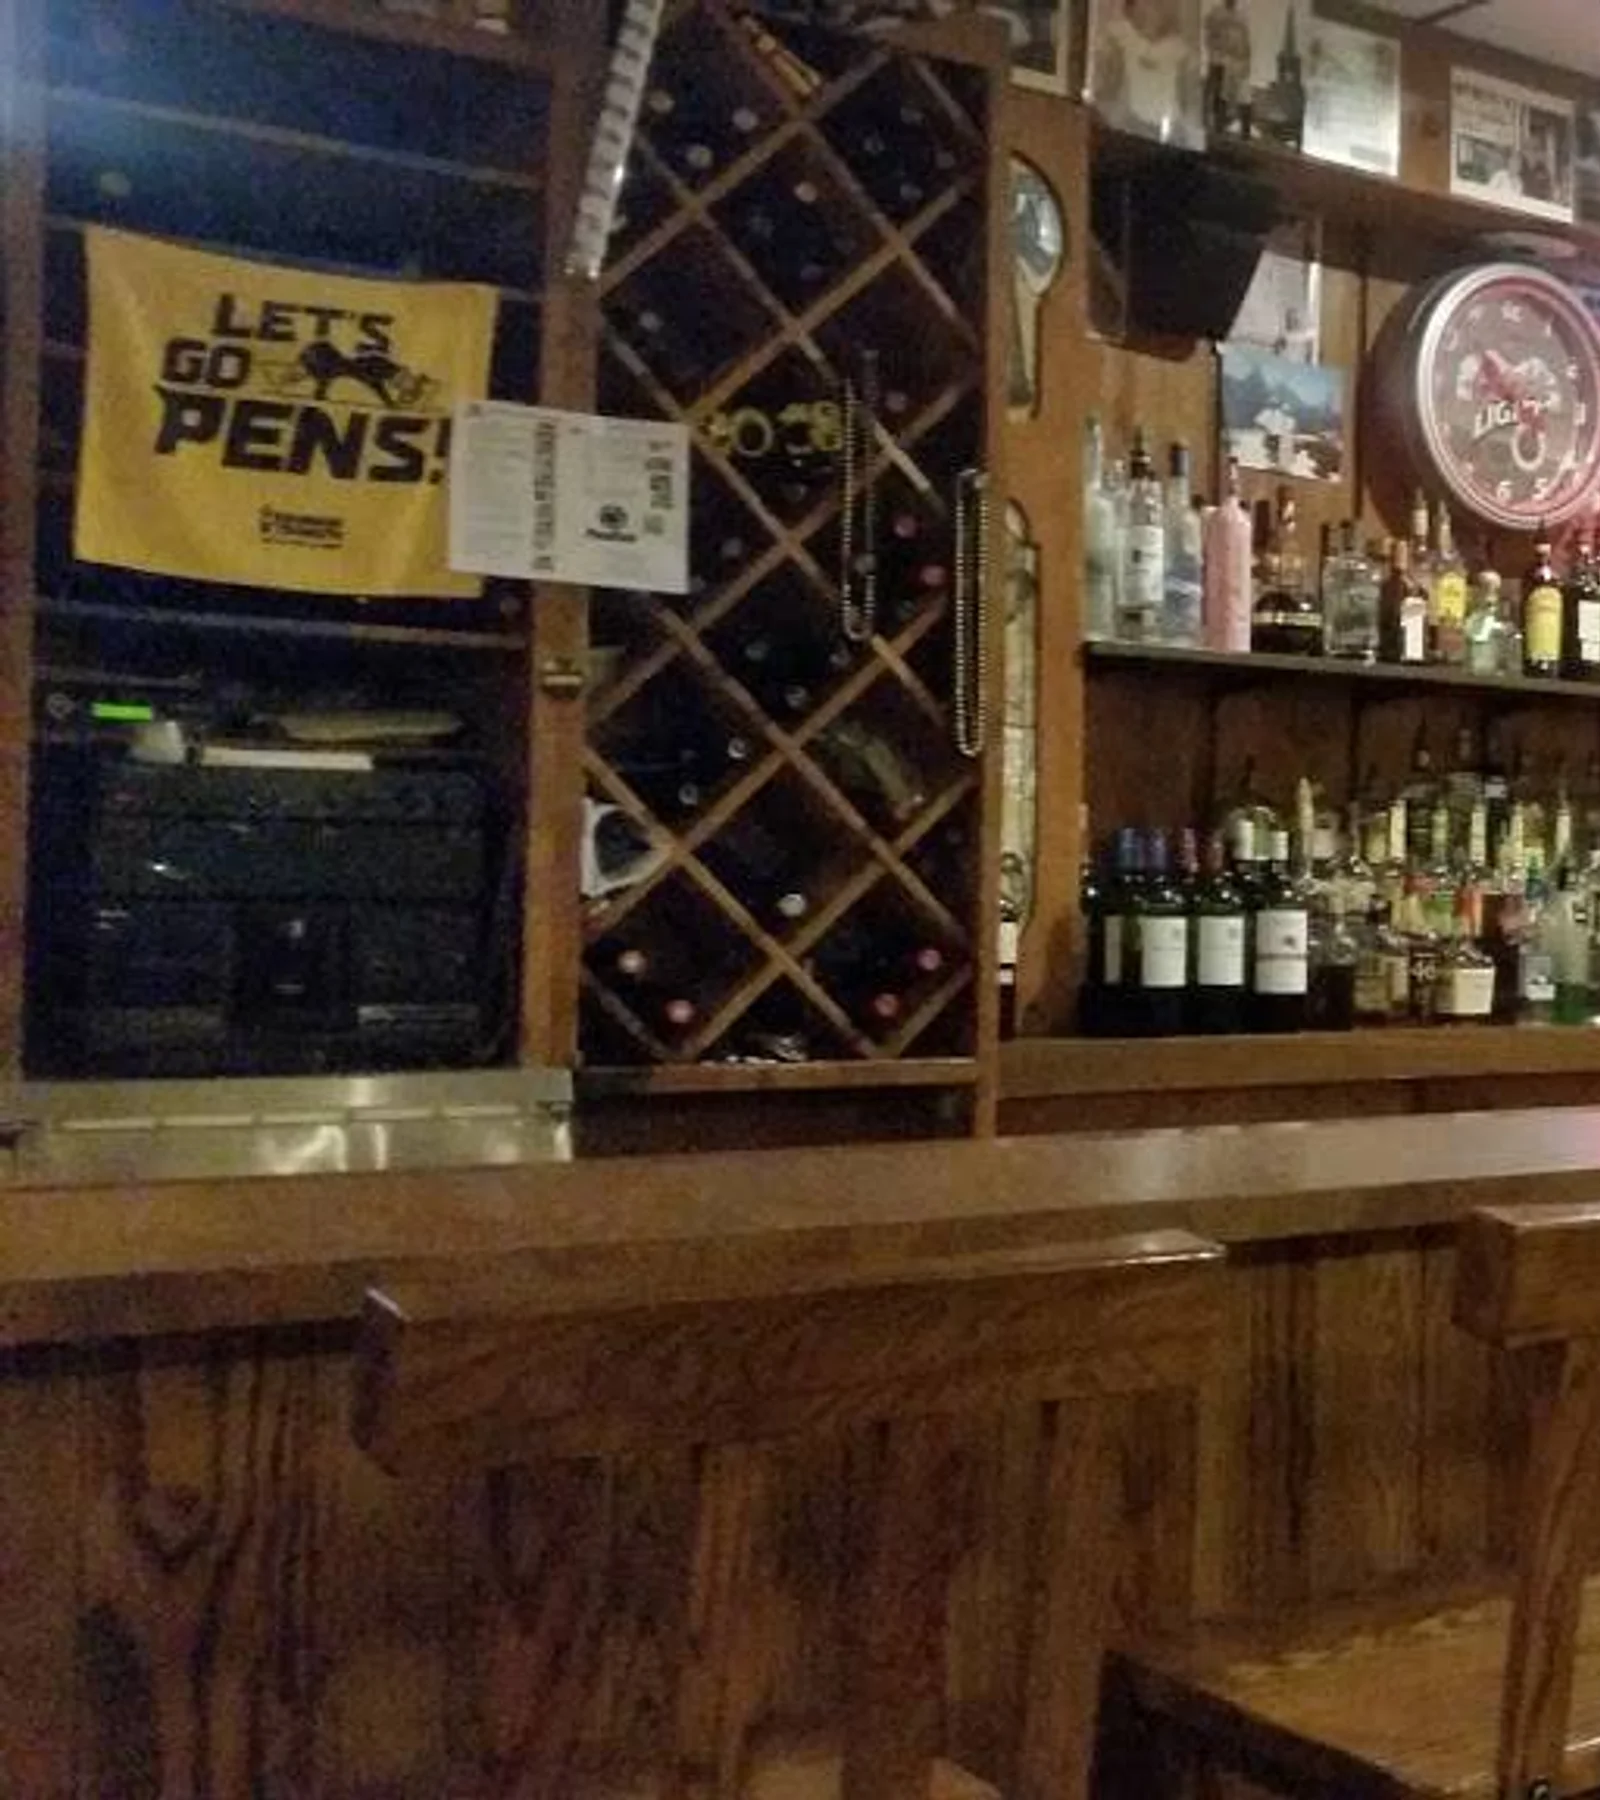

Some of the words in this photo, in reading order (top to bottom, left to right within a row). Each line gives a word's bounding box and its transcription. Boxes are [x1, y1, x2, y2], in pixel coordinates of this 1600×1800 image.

[212, 293, 396, 354] LET'S
[161, 335, 251, 389] GO
[152, 383, 453, 486] PENS!
